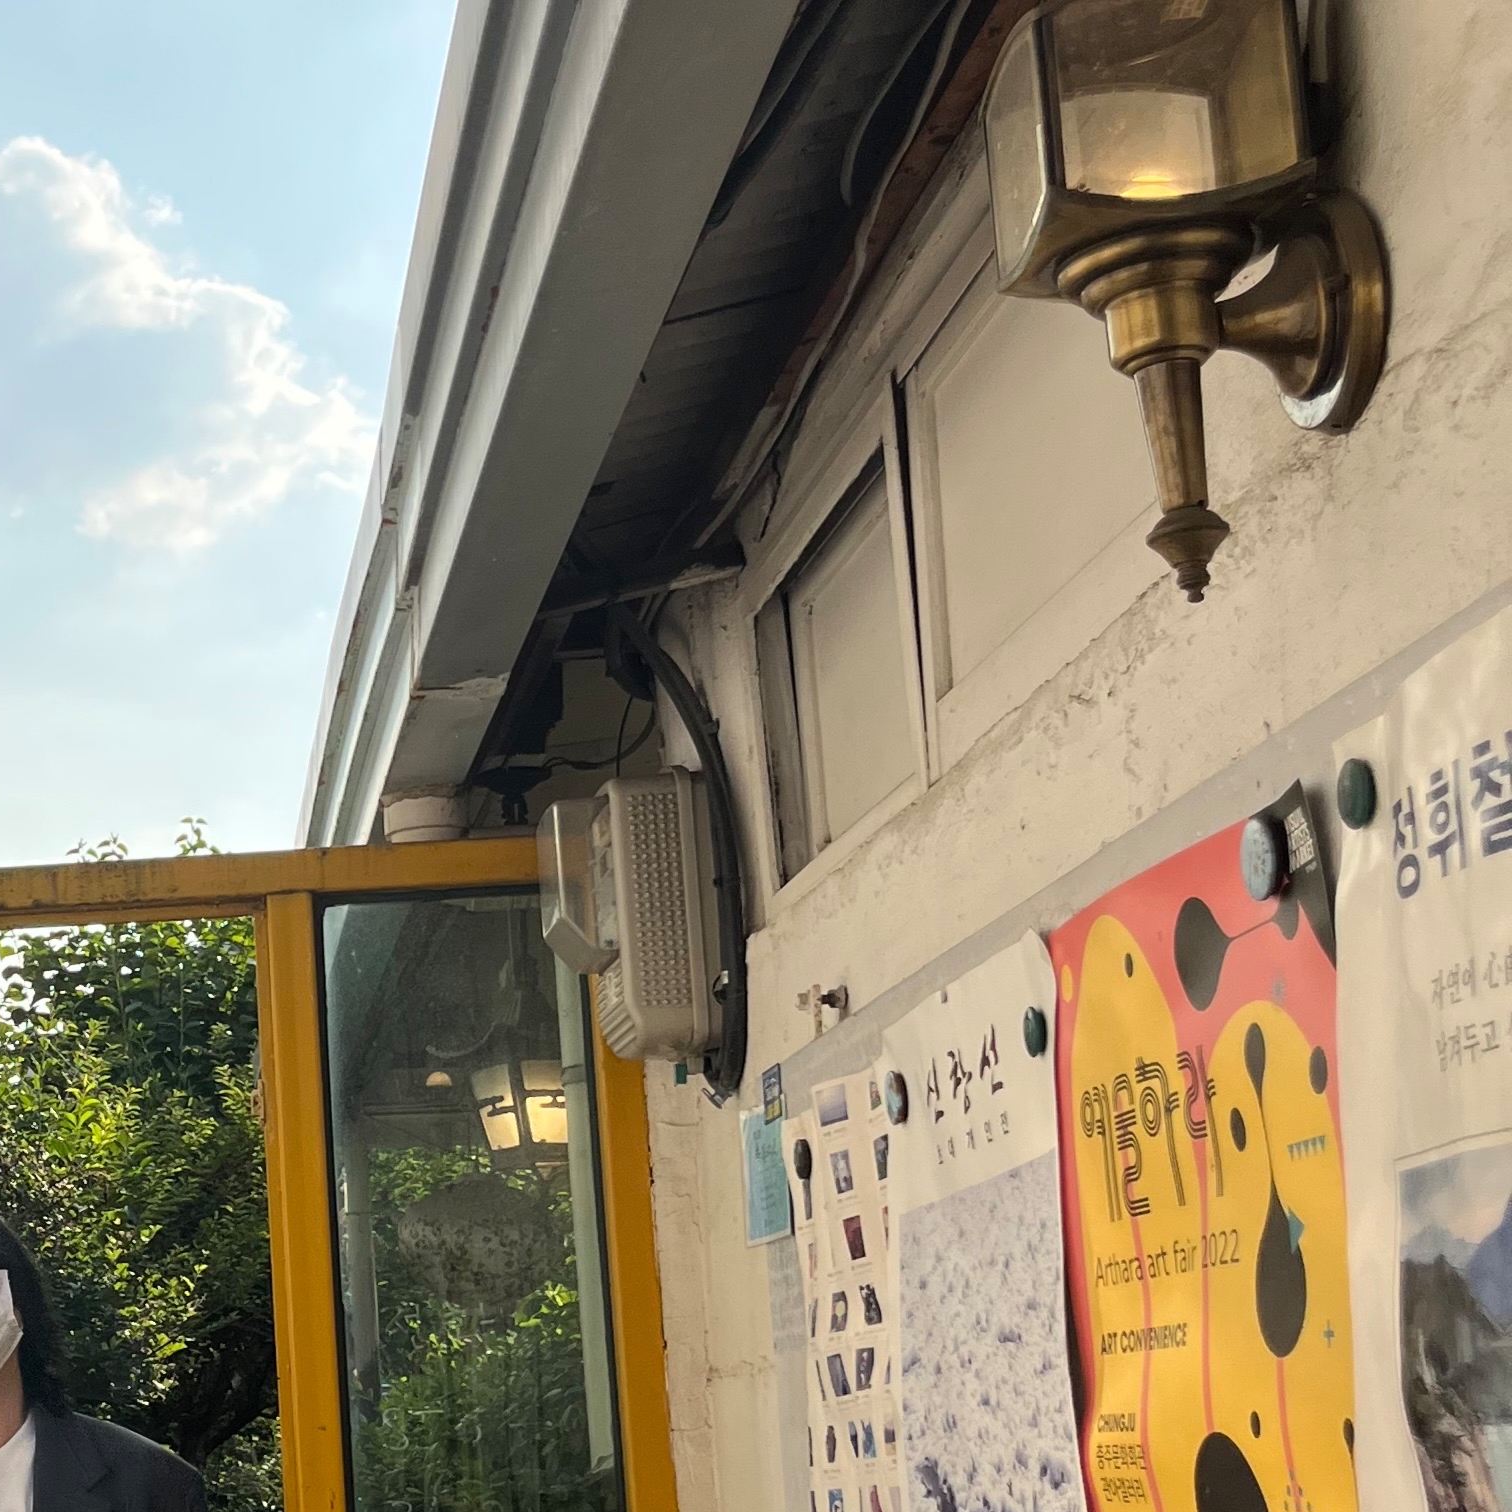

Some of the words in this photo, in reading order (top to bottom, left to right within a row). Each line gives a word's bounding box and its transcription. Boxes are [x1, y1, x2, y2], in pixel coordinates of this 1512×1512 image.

[1431, 957, 1476, 1010] 자연에
[1435, 1019, 1501, 1072] 남겨두고
[1096, 1253, 1144, 1288] Arthara
[1147, 1245, 1170, 1279] art
[1173, 1239, 1198, 1274] fair
[1201, 1229, 1240, 1269] 2022
[1100, 1331, 1118, 1356] ART
[1119, 1322, 1188, 1354] CONVENIENCE
[1097, 1412, 1136, 1433] CHUNGJU
[1096, 1443, 1148, 1470] 충주문화회관
[1099, 1476, 1148, 1504] 관아갤러리
